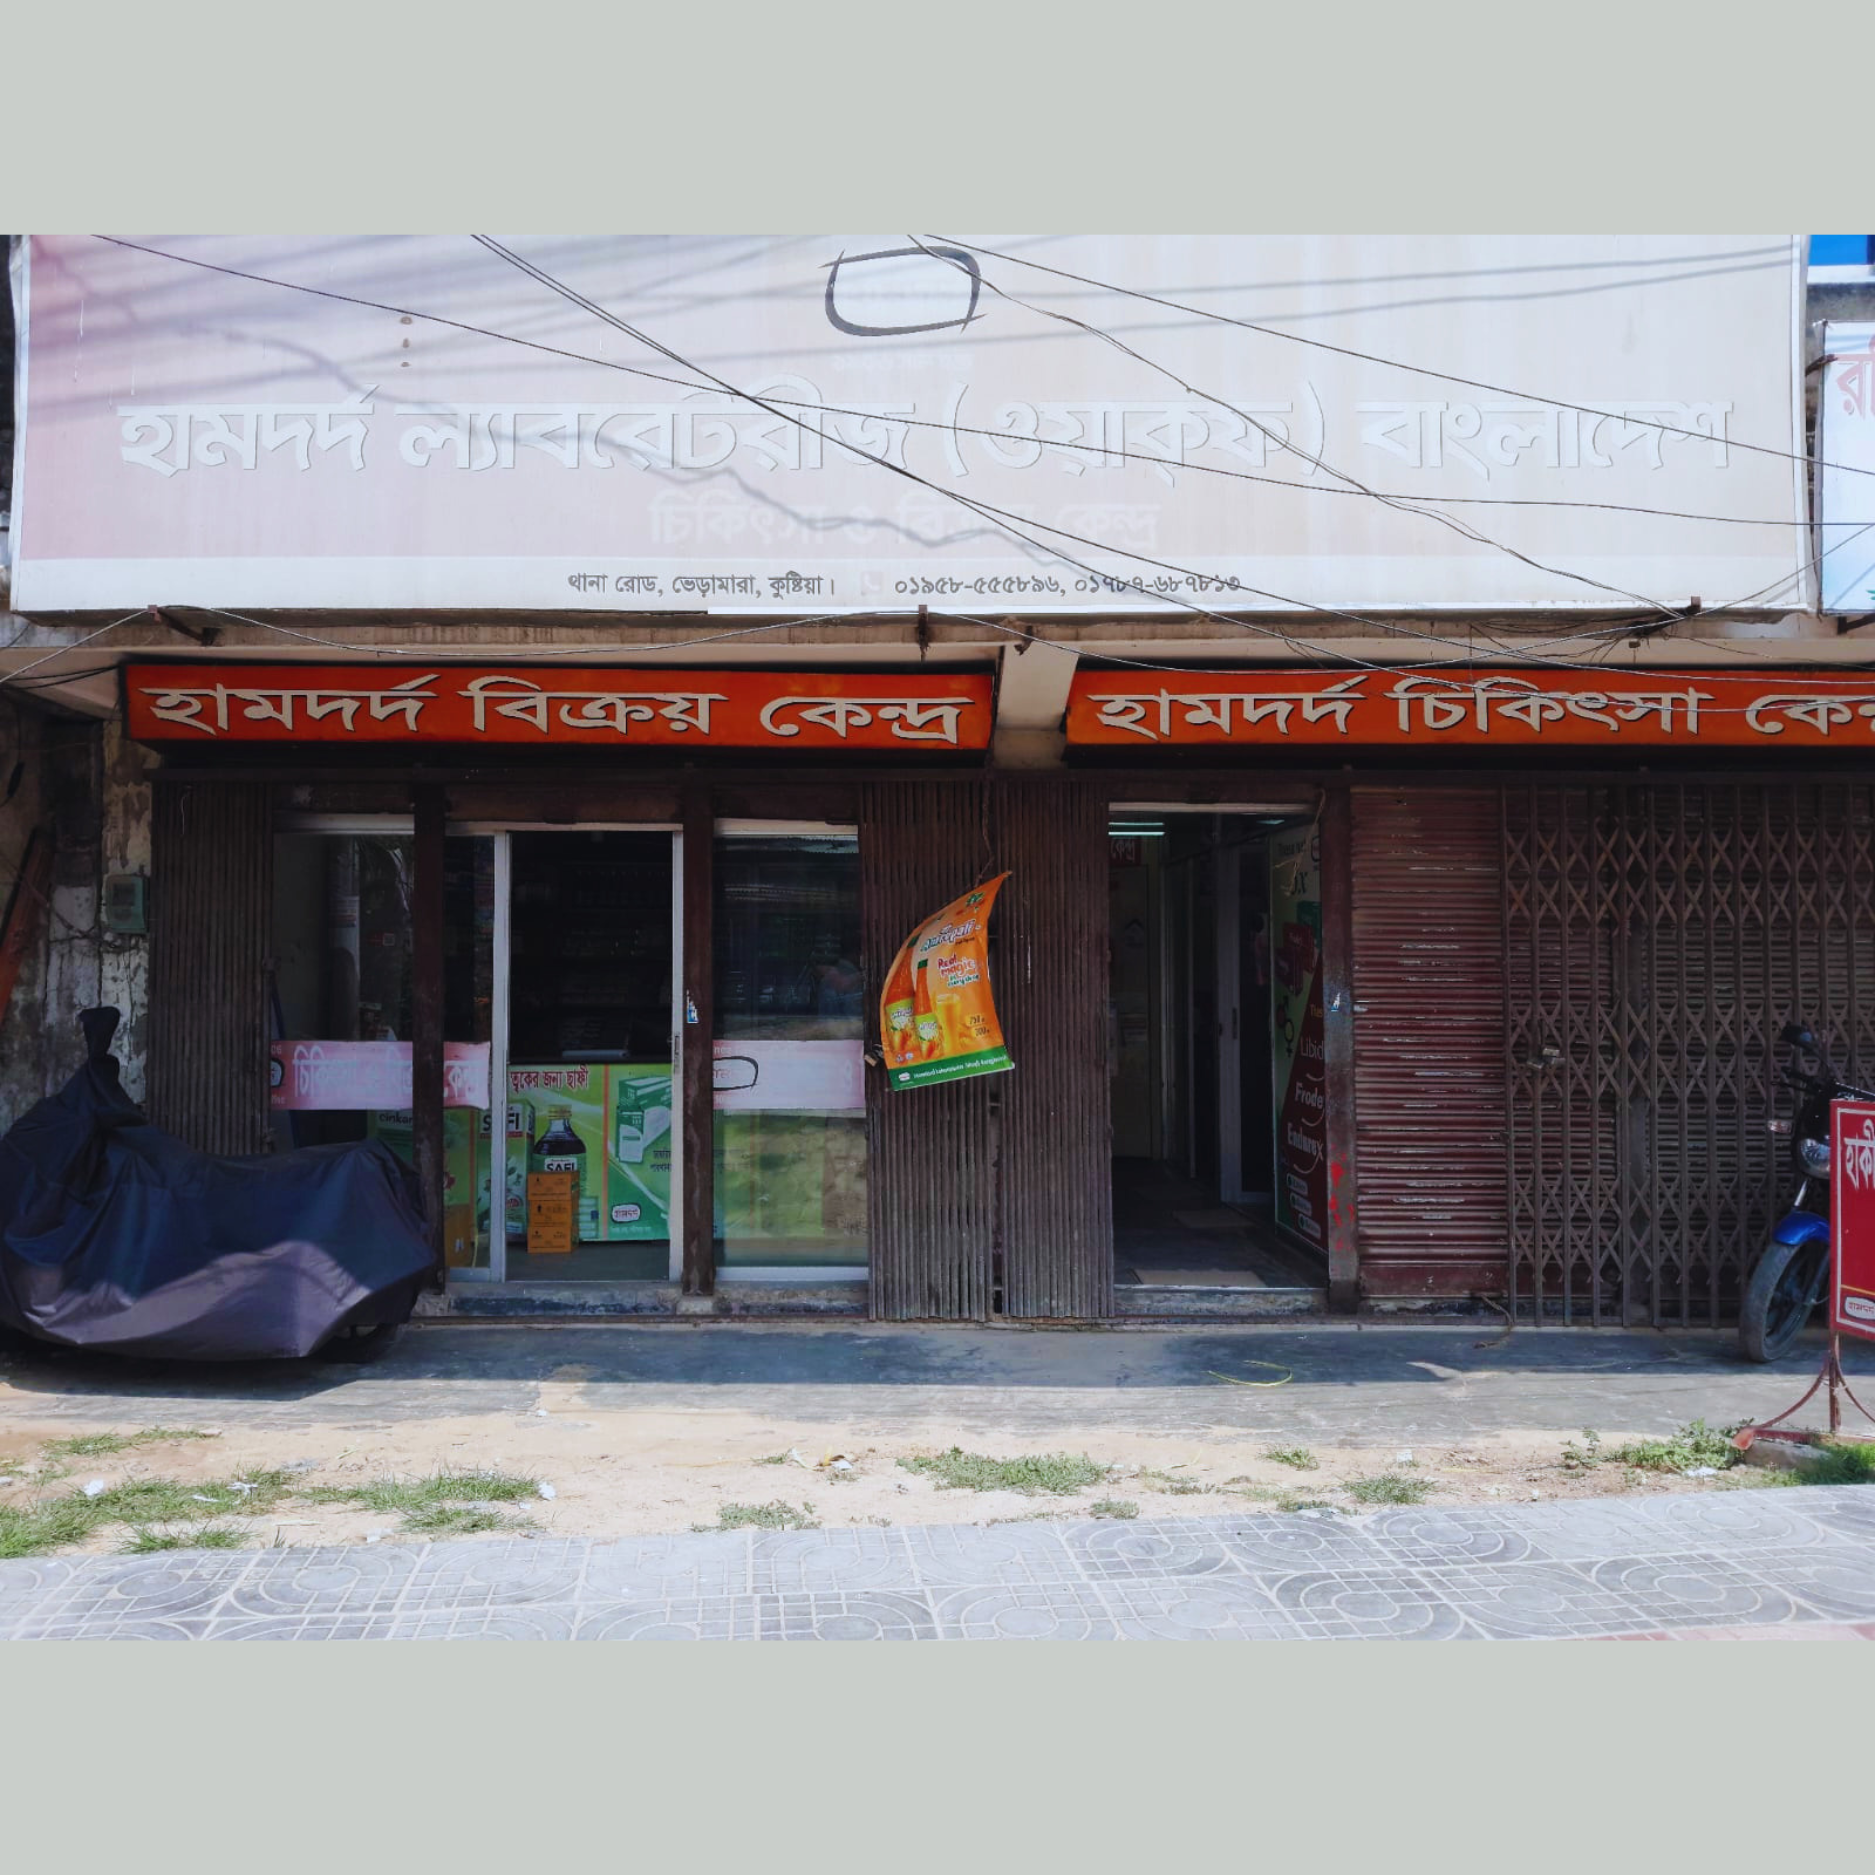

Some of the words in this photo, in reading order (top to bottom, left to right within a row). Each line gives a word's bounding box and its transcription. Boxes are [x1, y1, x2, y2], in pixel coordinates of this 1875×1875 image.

[1834, 334, 1875, 420] র
[117, 384, 379, 478] হামদর্দ
[1354, 400, 1735, 482] বাংলাদেশ
[568, 572, 608, 595] থানা
[140, 674, 441, 736] হামদর্দ
[458, 675, 729, 735] বিক্রয়
[760, 696, 975, 744] কেন্দ্র
[1086, 675, 1370, 741] হামদর্দ
[1383, 675, 1715, 736] চিকিৎসা
[1300, 1036, 1325, 1061] Libid
[1294, 1082, 1324, 1109] Frode
[483, 1112, 520, 1132] SFI
[547, 1162, 575, 1172] SAFI
[1843, 1118, 1875, 1194] হাকী
